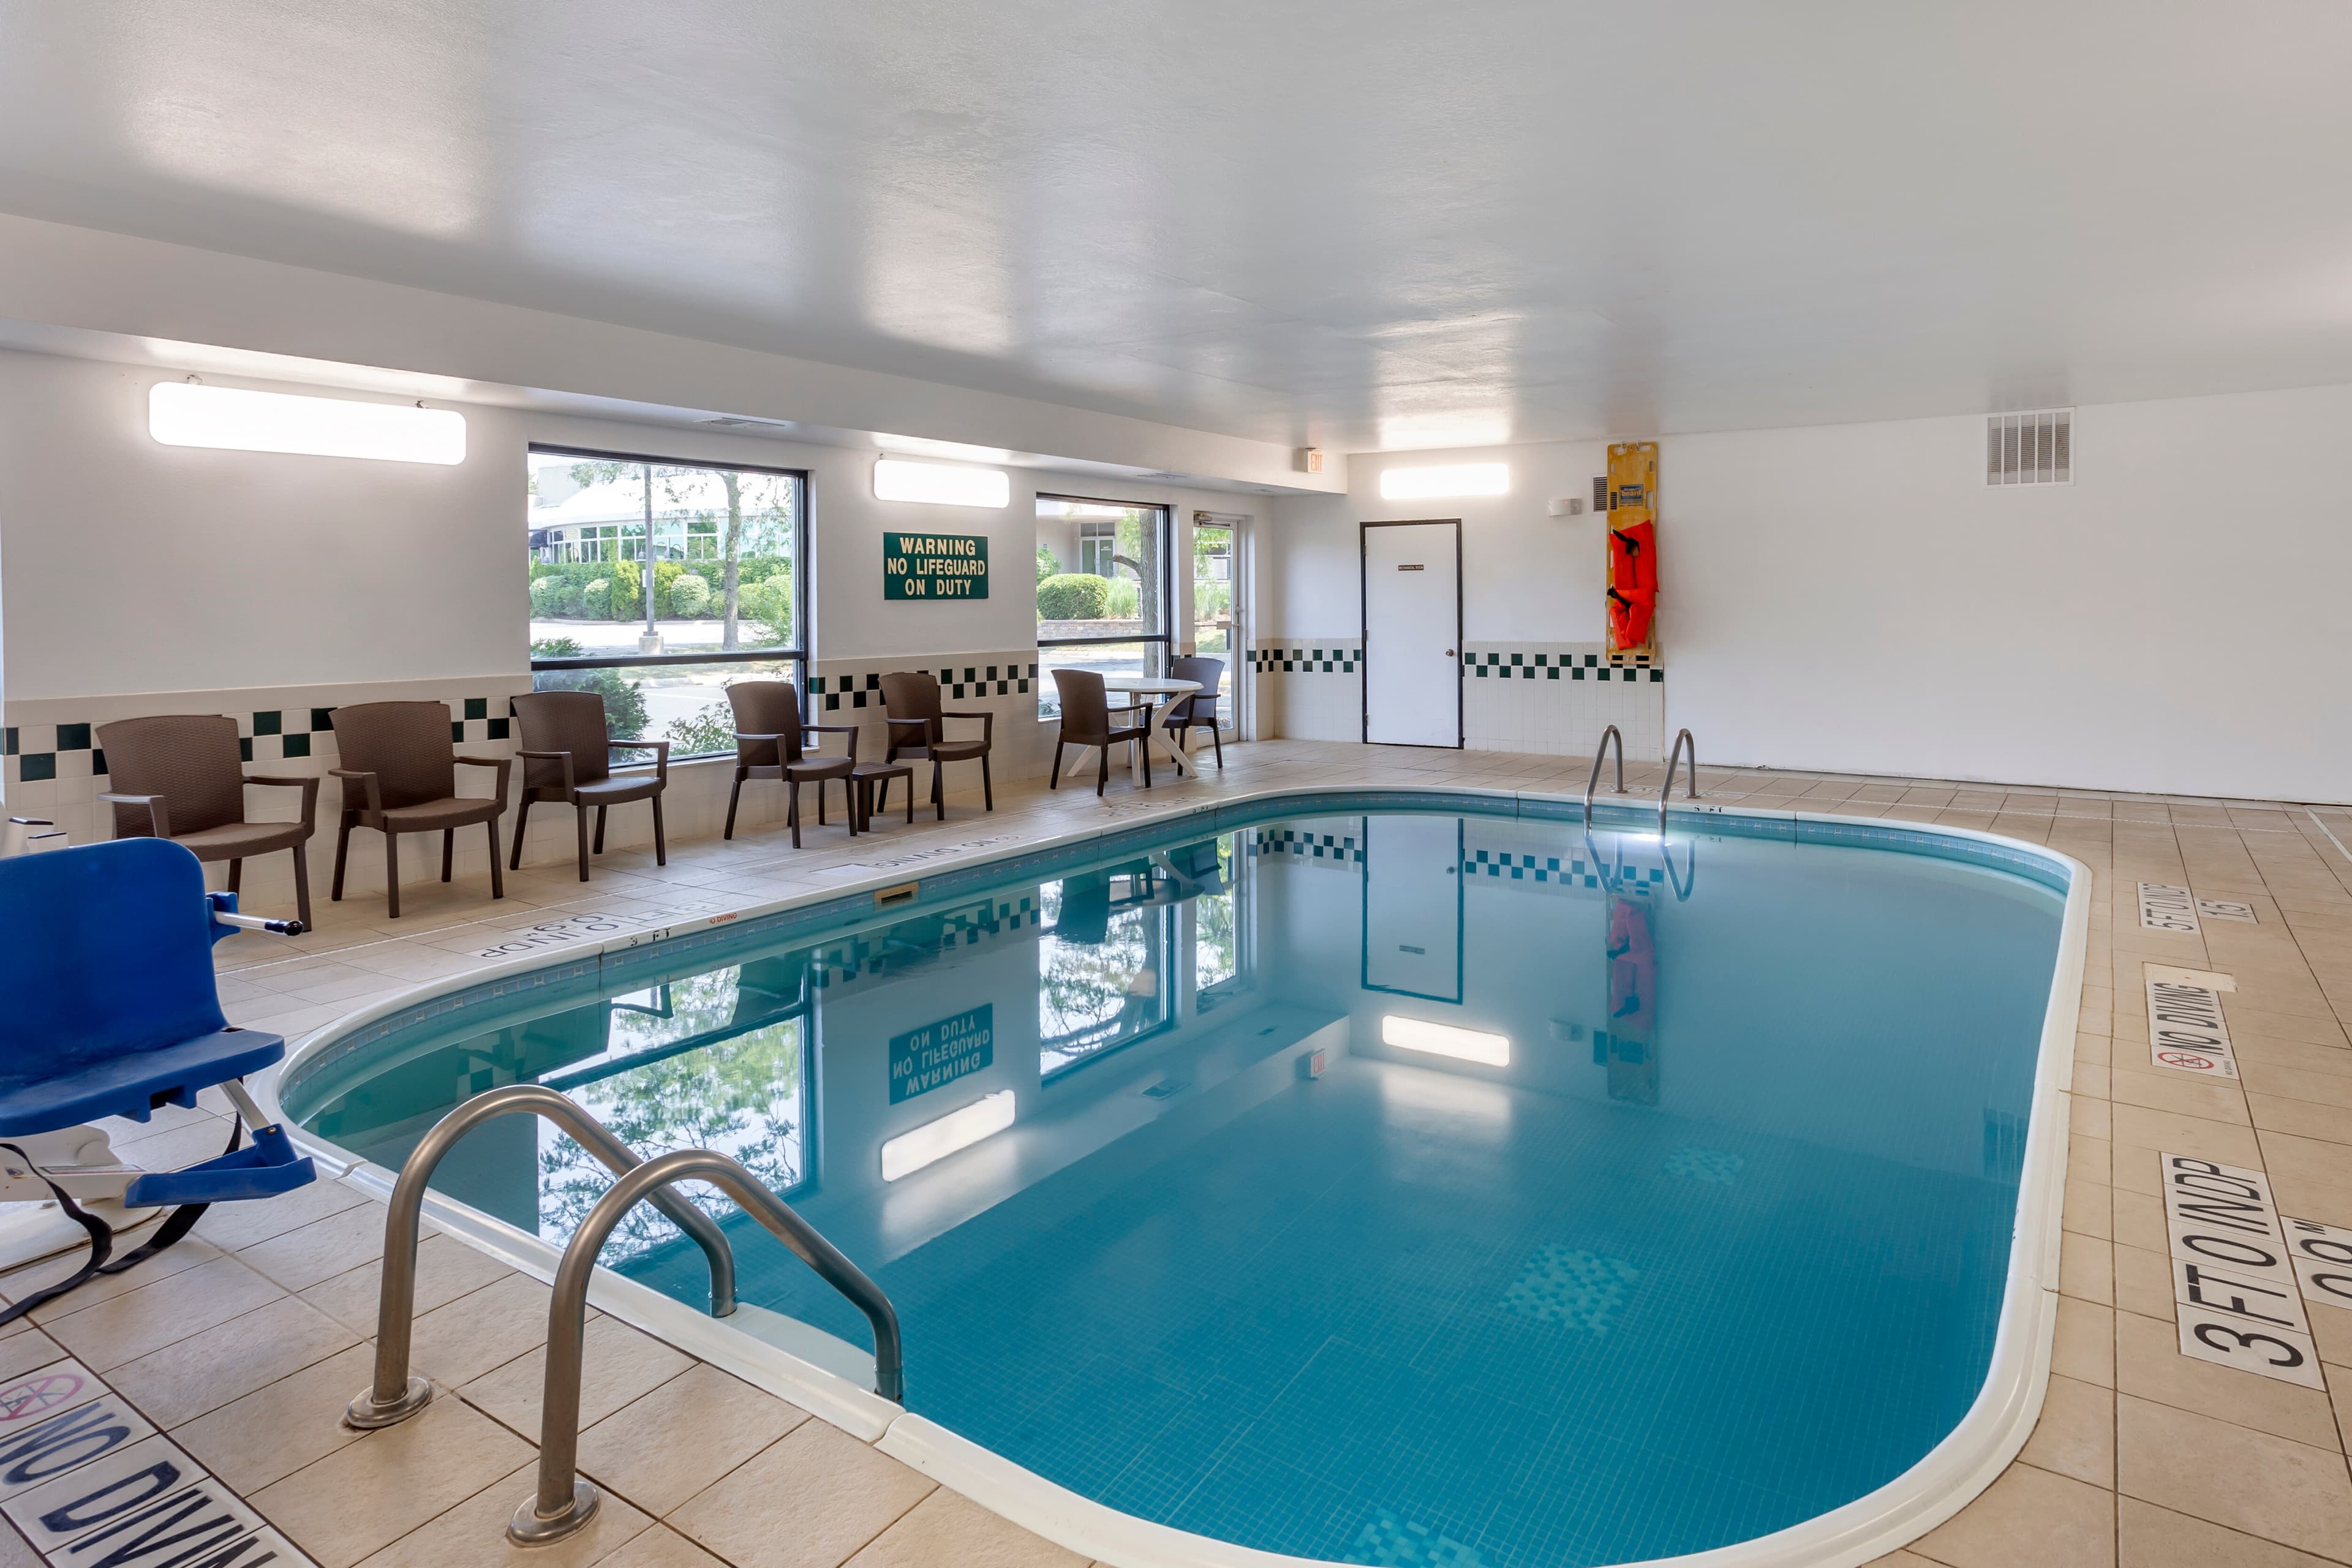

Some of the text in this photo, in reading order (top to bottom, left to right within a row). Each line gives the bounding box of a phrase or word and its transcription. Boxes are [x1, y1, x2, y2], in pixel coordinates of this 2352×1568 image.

[1311, 453, 1322, 472] EXIT
[899, 537, 976, 556] WARNING
[888, 557, 986, 576] NO LIFEGUARD
[905, 578, 971, 596] ON DUTY
[875, 848, 961, 868] DIVING
[717, 913, 737, 922] DIVING
[652, 928, 671, 943] FT
[2154, 982, 2225, 1056] NO DIVING
[2185, 1263, 2294, 1327] FT
[2194, 1323, 2304, 1368] 3
[0, 1401, 132, 1486] NO
